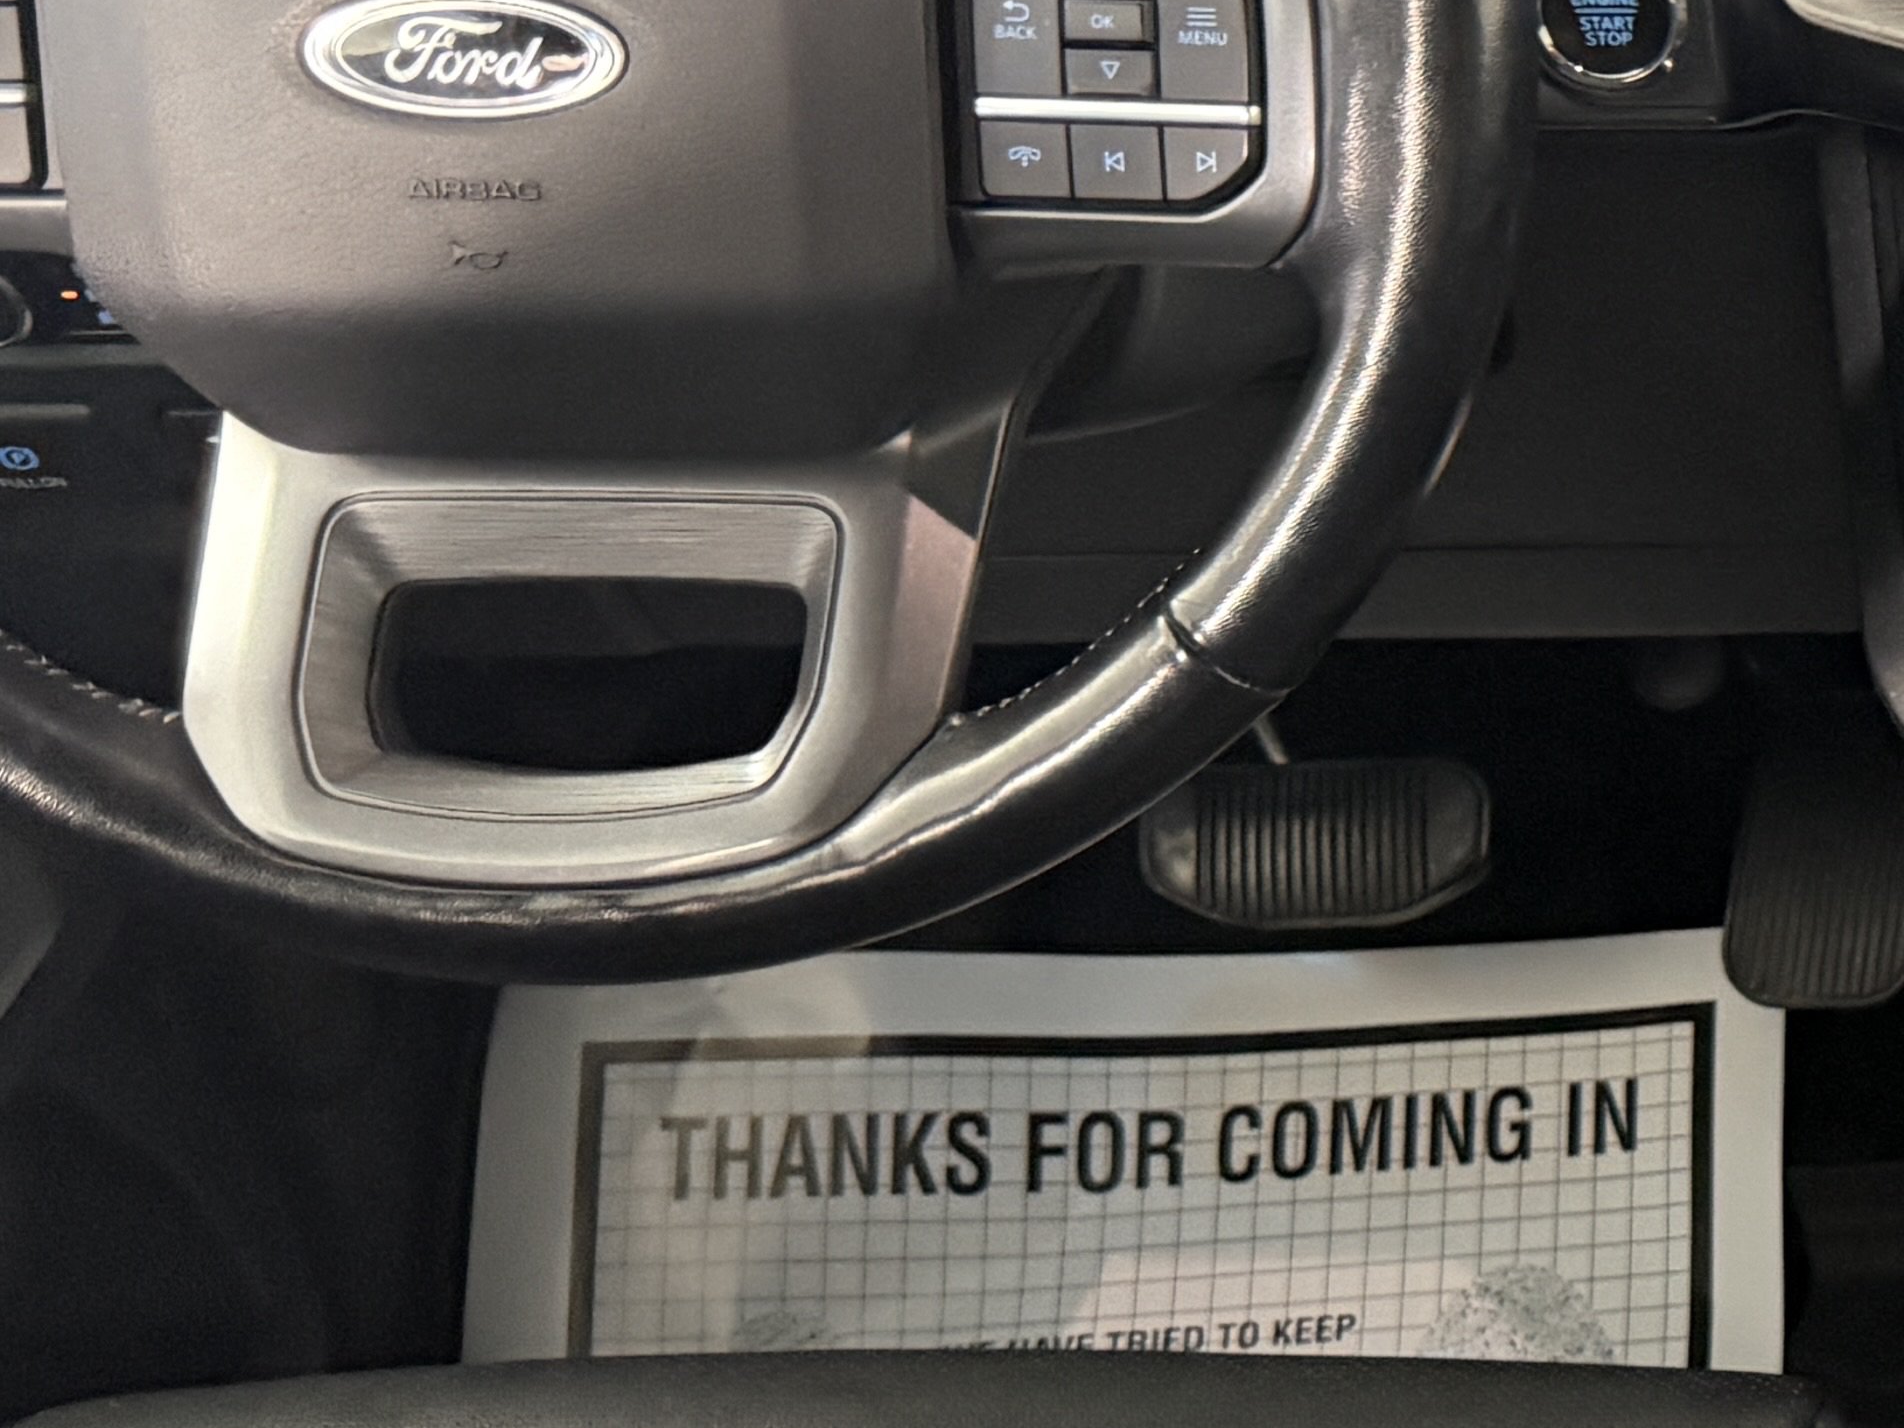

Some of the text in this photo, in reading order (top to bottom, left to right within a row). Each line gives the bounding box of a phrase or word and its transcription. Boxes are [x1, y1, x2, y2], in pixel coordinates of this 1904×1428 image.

[1090, 13, 1116, 30] OK
[1579, 16, 1636, 32] START
[994, 24, 1038, 41] BACK
[1178, 30, 1228, 47] MENU
[1585, 30, 1634, 47] STOP
[384, 14, 544, 90] Ford
[406, 177, 542, 202] AIRBAG
[660, 1077, 1640, 1202] THANKS FOR COMING IN
[1218, 1320, 1261, 1351] TO
[1272, 1312, 1357, 1347] KEEP
